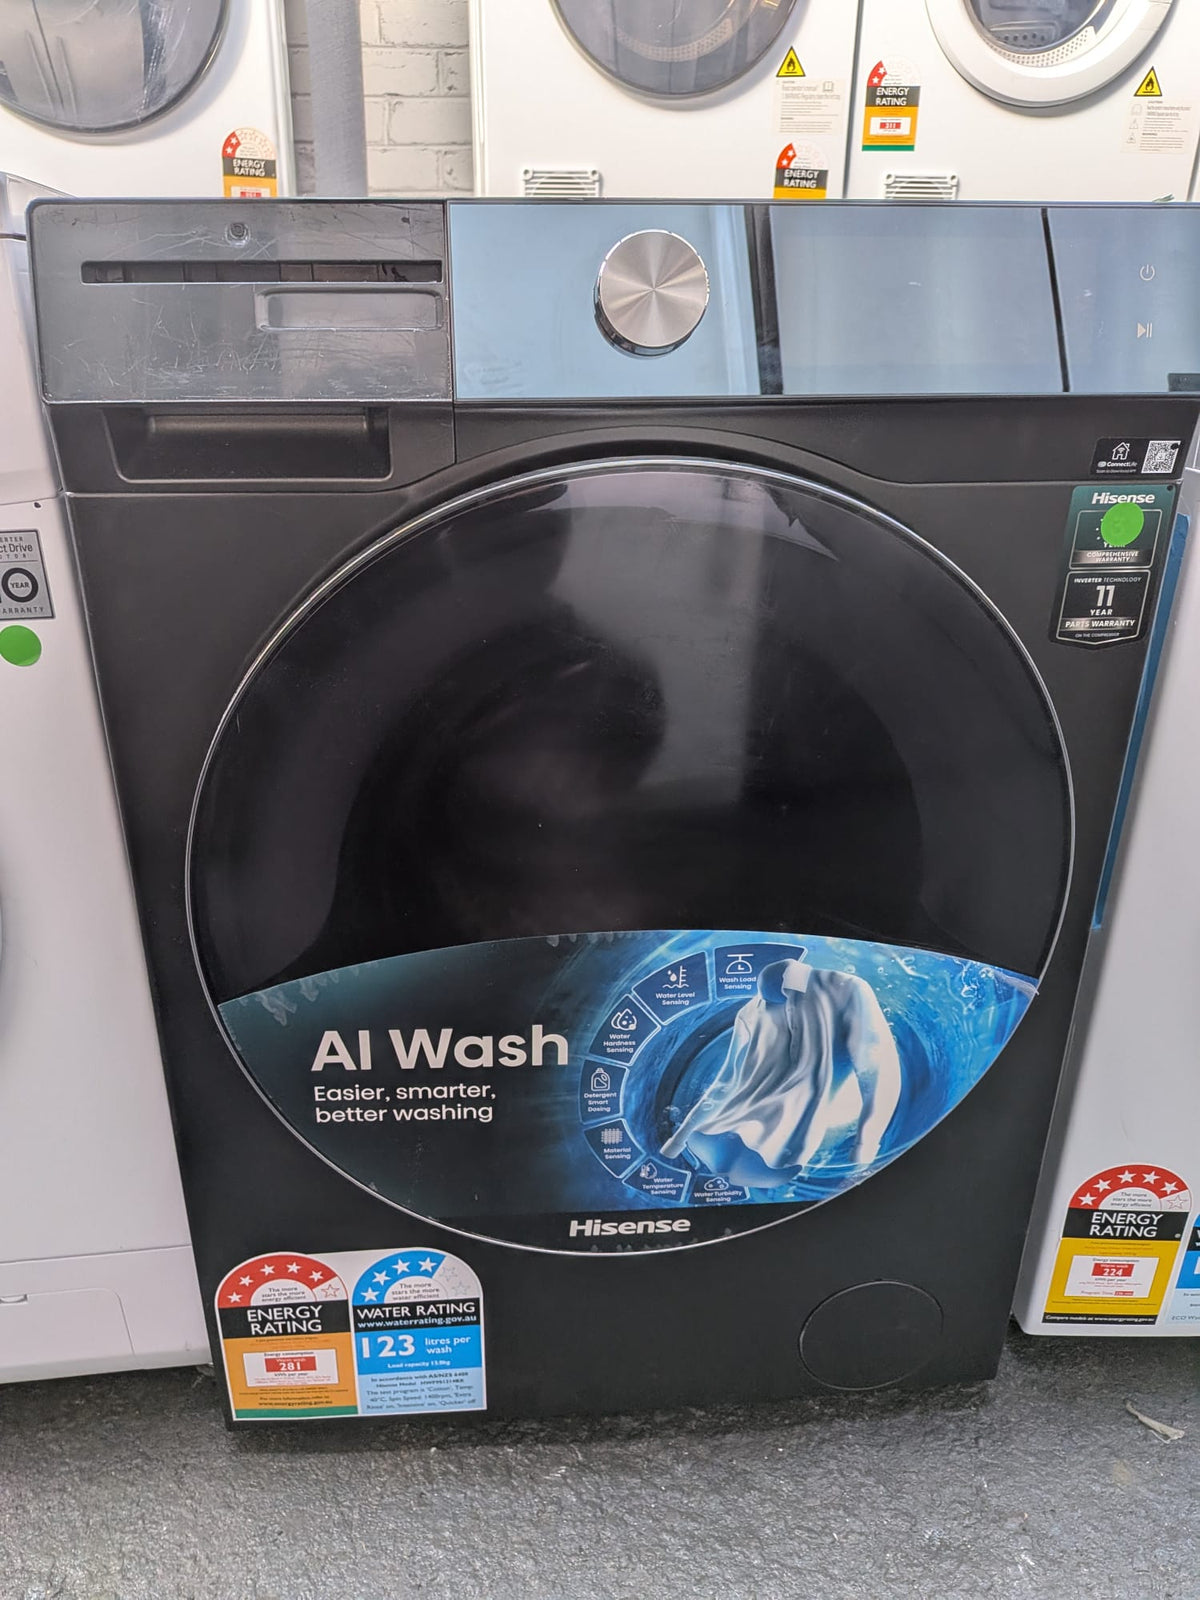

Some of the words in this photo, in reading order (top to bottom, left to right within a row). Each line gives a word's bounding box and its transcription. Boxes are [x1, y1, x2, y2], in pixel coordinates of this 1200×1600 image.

[876, 87, 910, 96] ENERGY
[876, 98, 907, 106] RATING
[233, 158, 266, 169] ENERGY
[234, 167, 266, 177] RATING
[784, 169, 819, 179] ENERGY
[783, 179, 816, 188] RATING
[1092, 492, 1155, 504] Hisense
[9, 543, 33, 553] Drive
[1096, 585, 1115, 606] 11
[311, 1030, 372, 1071] AI
[388, 1024, 569, 1069] Wash
[314, 1084, 390, 1102] Easier,
[396, 1083, 496, 1100] smarter,
[316, 1106, 388, 1123] better
[393, 1104, 493, 1123] washing
[1091, 1212, 1163, 1225] ENERGY
[569, 1219, 691, 1237] Hisense
[1089, 1225, 1158, 1238] RATING
[246, 1305, 323, 1322] ENERGY
[357, 1306, 411, 1319] WATER
[416, 1302, 475, 1316] RATING
[251, 1320, 322, 1335] RATING
[358, 1315, 477, 1328] www.waterrating.gov.au
[361, 1334, 416, 1358] 123
[425, 1337, 450, 1345] litres
[454, 1336, 471, 1346] per
[426, 1346, 452, 1354] wash
[279, 1362, 301, 1371] 281
